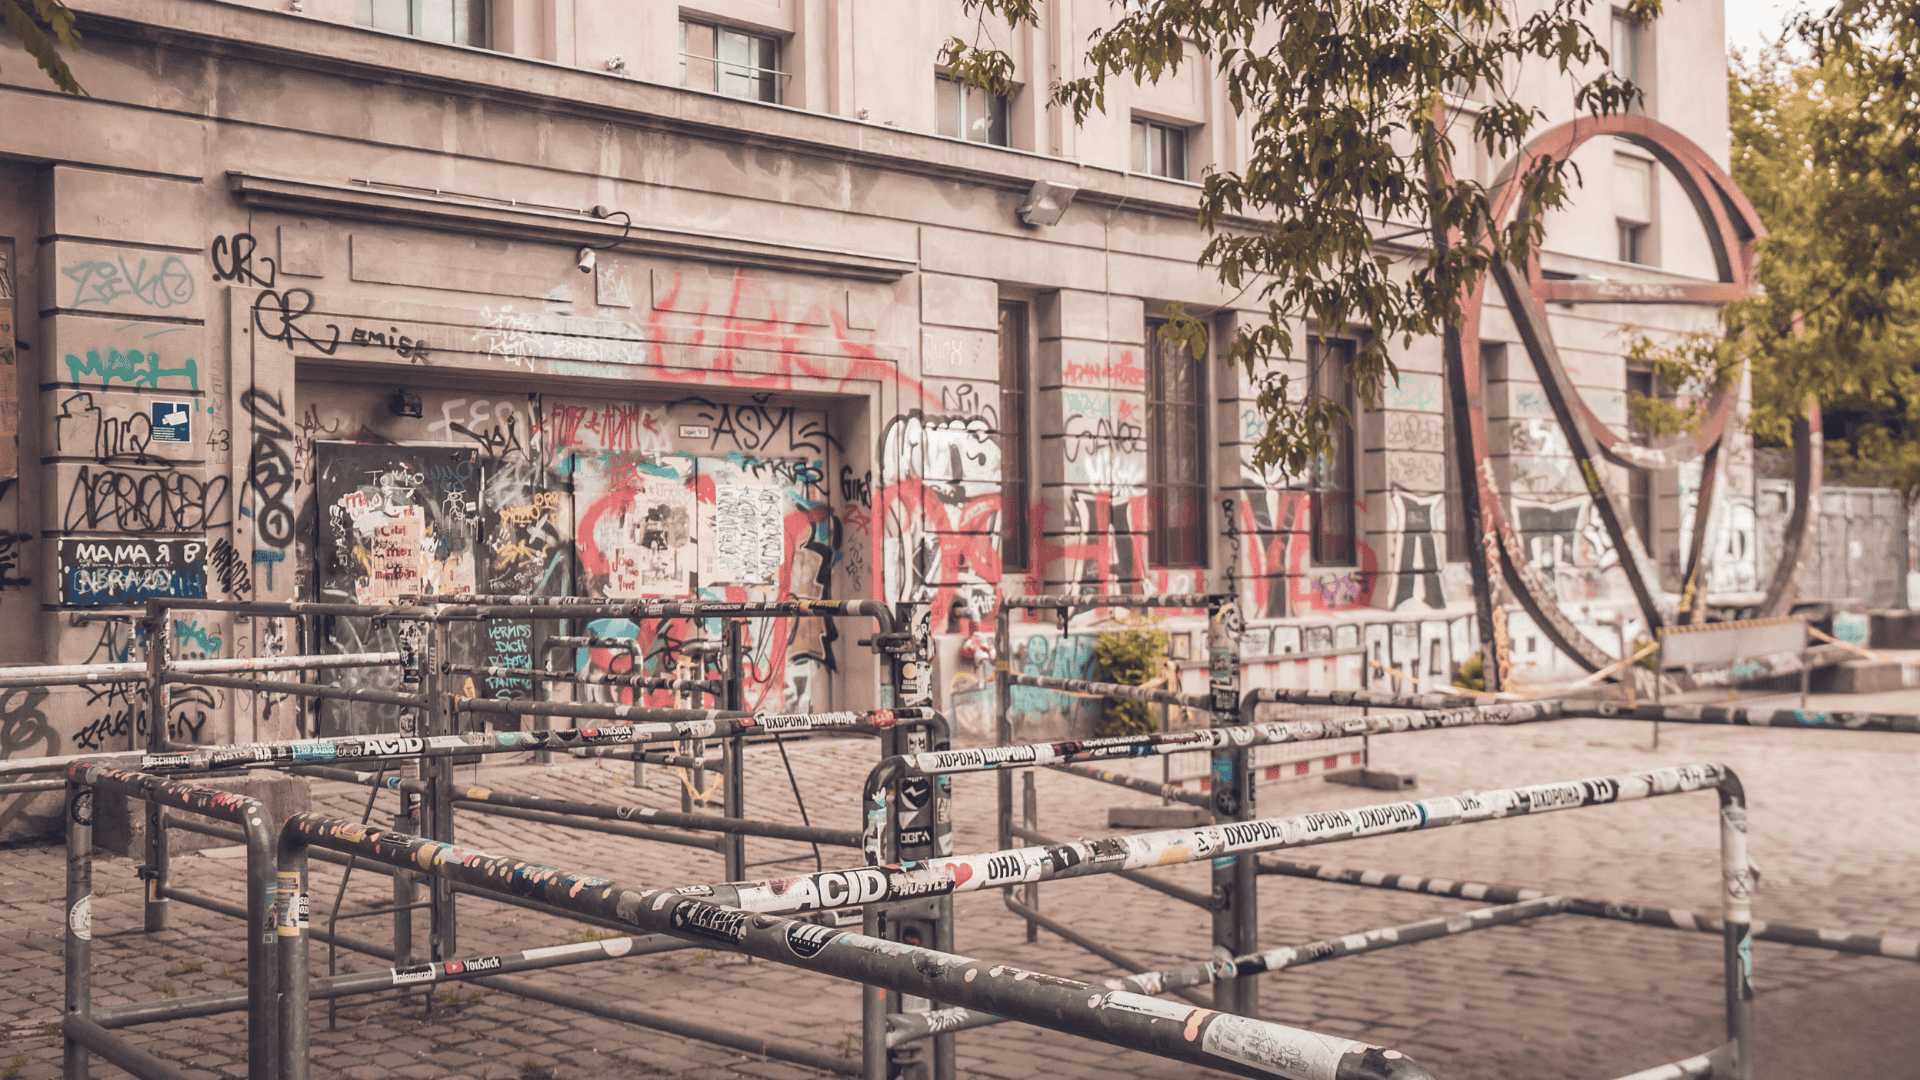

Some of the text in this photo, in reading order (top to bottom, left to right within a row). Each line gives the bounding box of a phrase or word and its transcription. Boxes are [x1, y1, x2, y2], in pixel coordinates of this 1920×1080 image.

[364, 737, 424, 756] ACID
[1359, 803, 1419, 829] ОХОРОНА
[1223, 819, 1280, 846] ОХОРОН
[798, 869, 888, 909] ACID
[900, 878, 948, 897] HUSTLE
[464, 956, 500, 972] YouSuck
